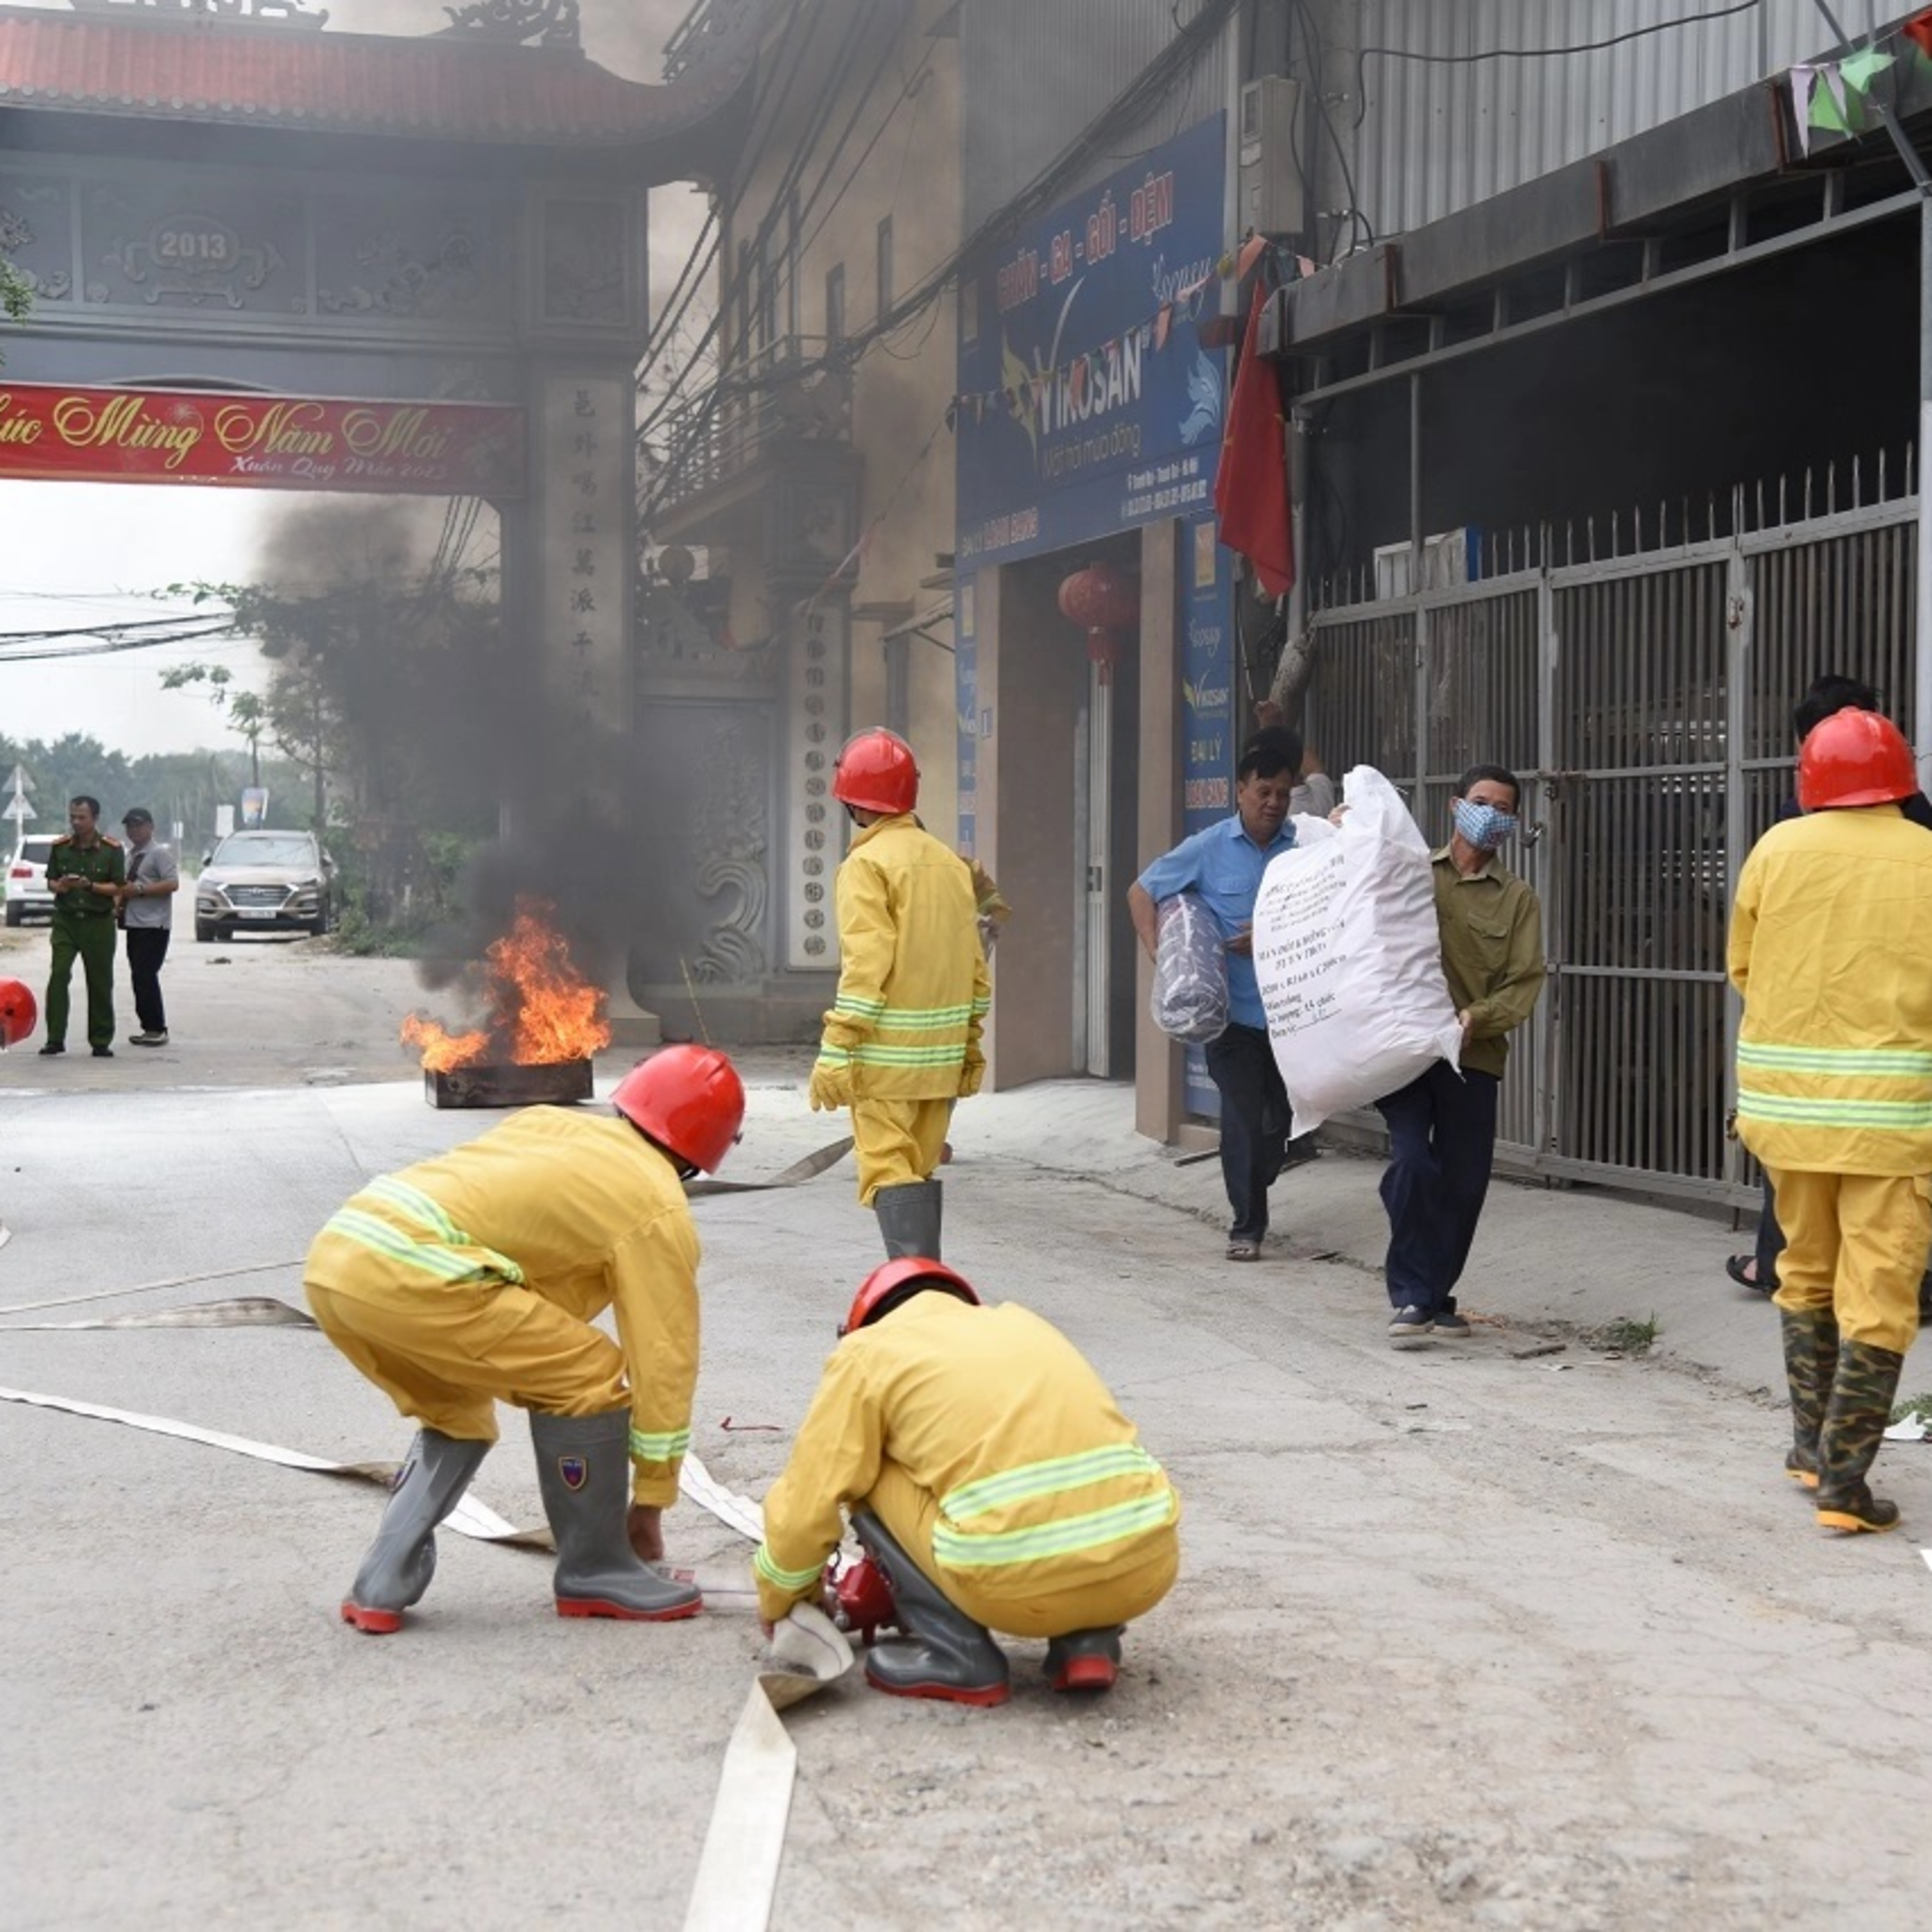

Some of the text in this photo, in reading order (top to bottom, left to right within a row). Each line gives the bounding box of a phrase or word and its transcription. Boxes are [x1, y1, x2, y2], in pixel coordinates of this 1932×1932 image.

[162, 232, 226, 258] 2013
[1050, 230, 1072, 285] GA
[53, 395, 201, 469] Mừng
[214, 401, 334, 455] Năm
[341, 406, 450, 459] Mới
